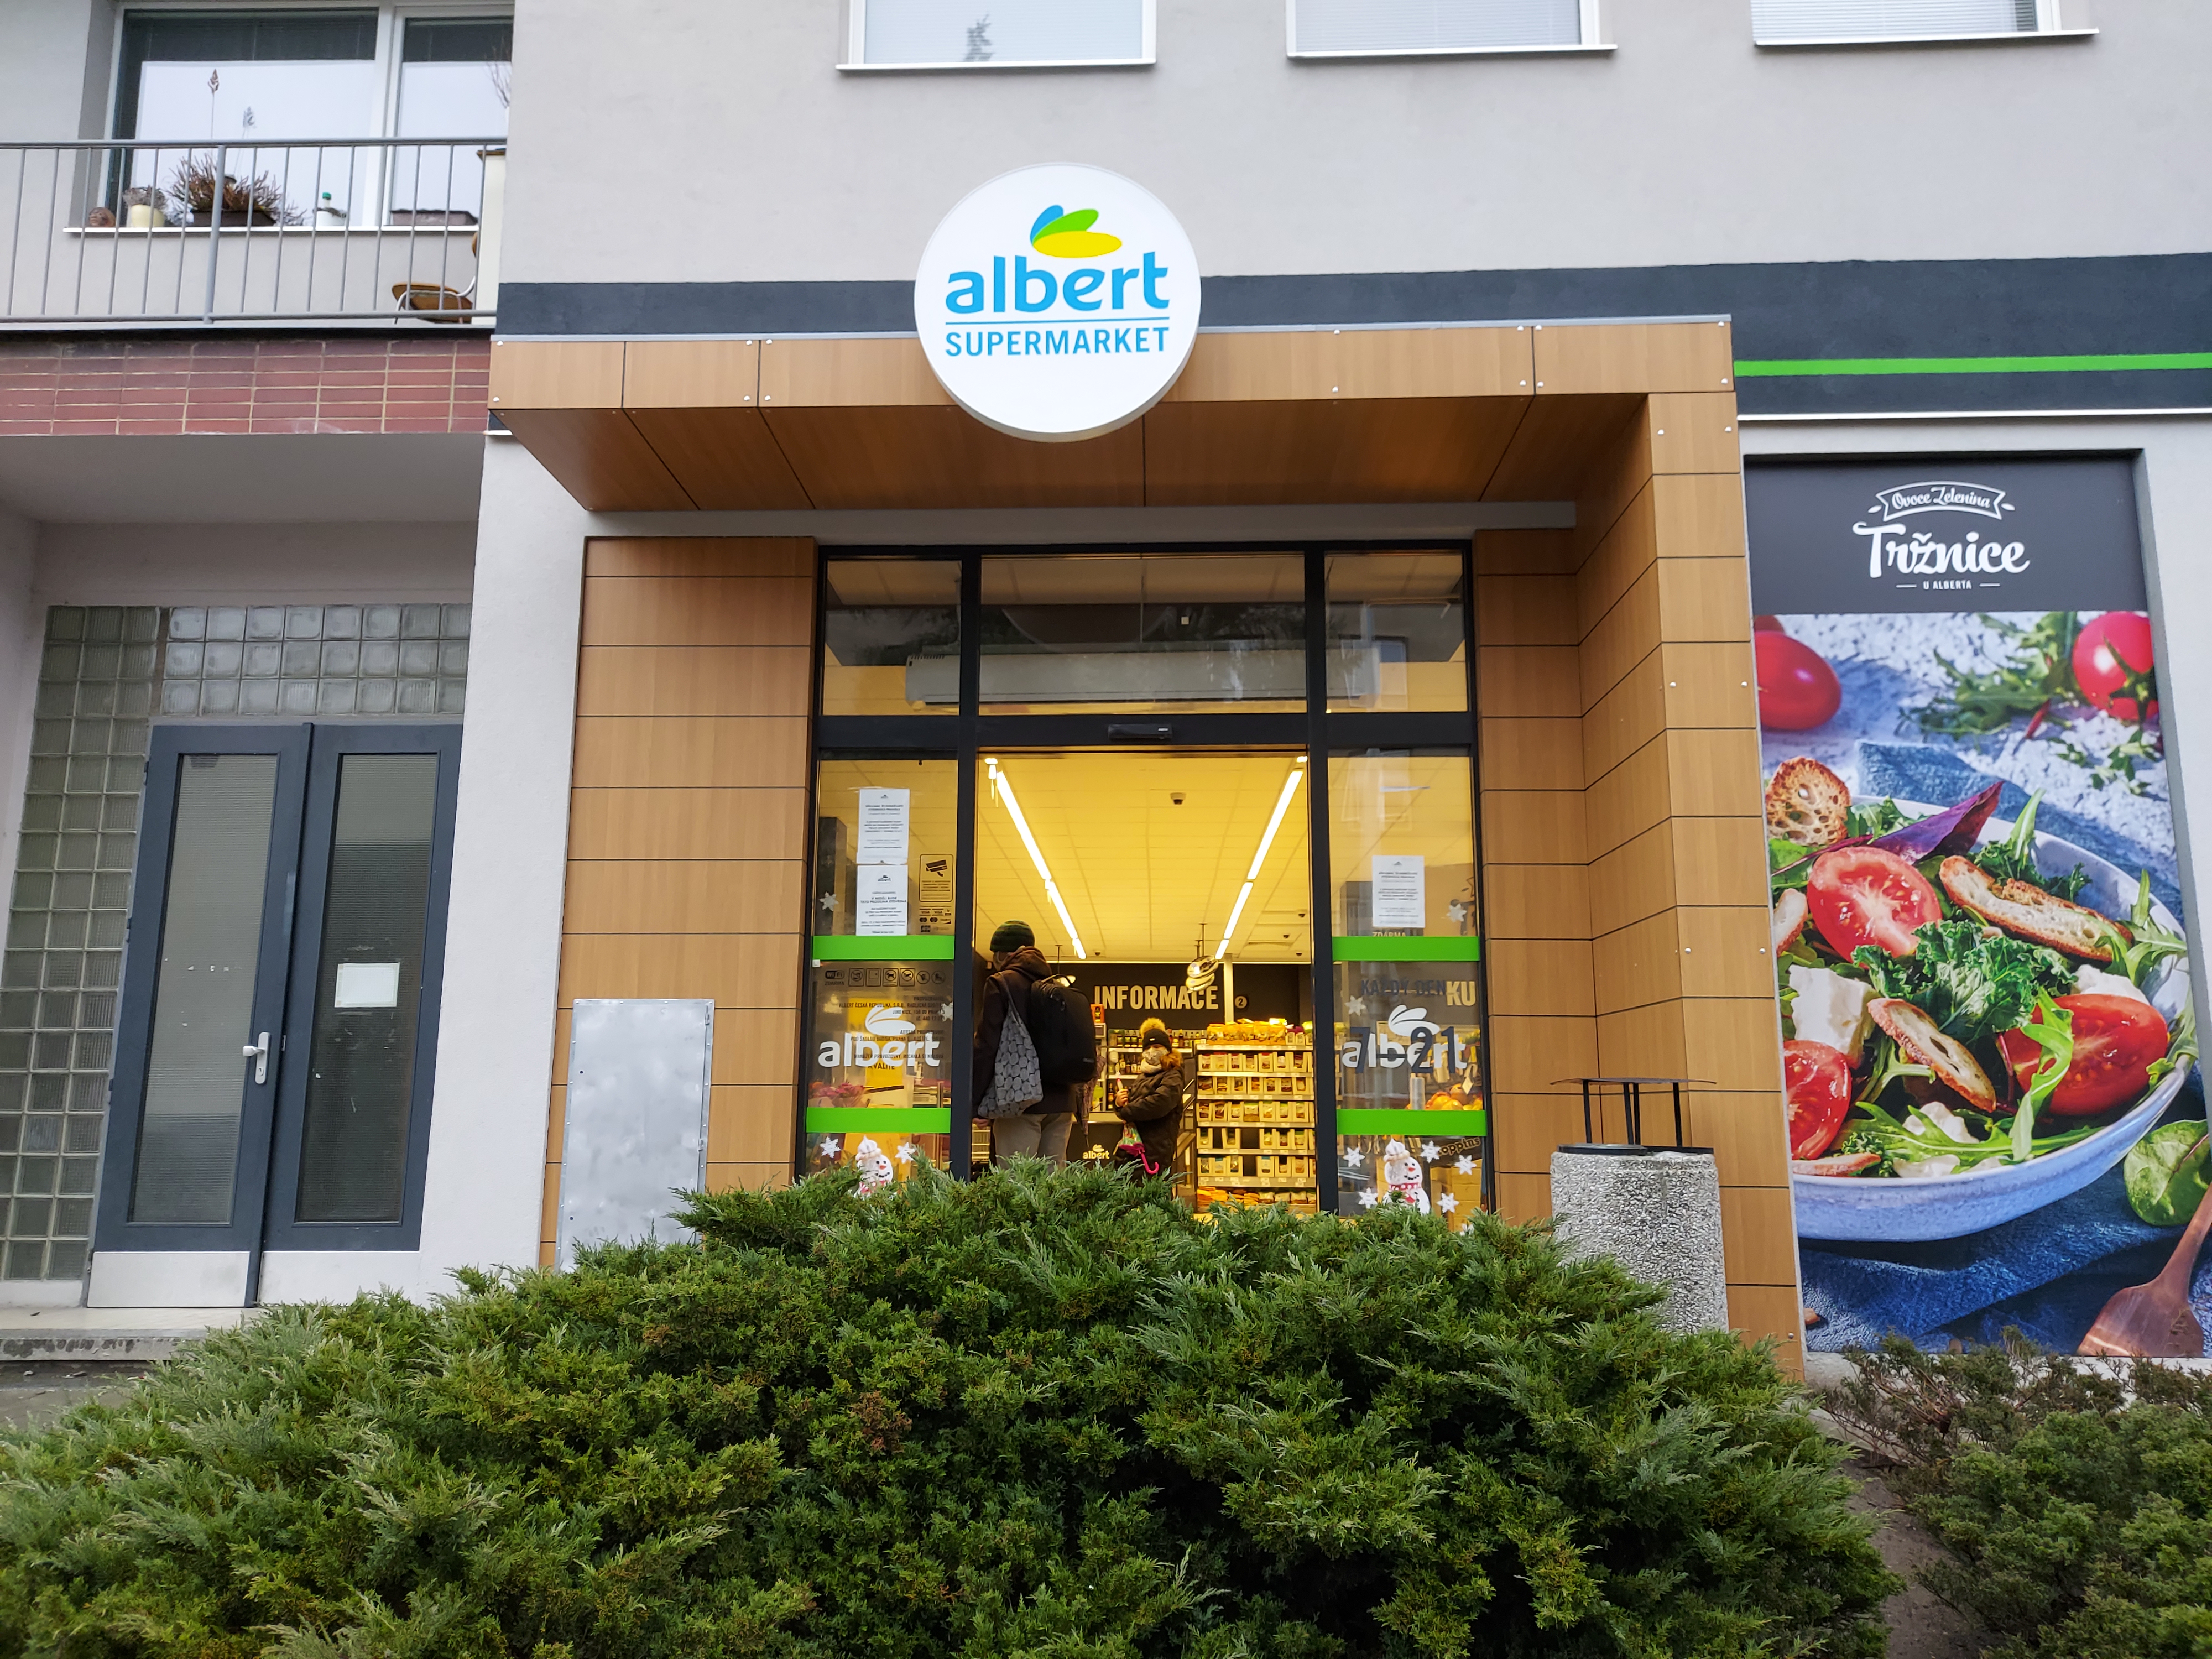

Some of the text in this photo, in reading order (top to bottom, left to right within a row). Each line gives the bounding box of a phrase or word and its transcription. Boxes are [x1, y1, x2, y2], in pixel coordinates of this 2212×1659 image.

[945, 251, 1170, 314] albert
[945, 327, 1170, 357] SUPERMARKET
[1892, 486, 1991, 509] Ovoce Zelenina
[1852, 521, 2031, 578] Tržnice
[1923, 580, 1972, 590] U ALBERTA
[1094, 985, 1219, 1009] INFORMACE
[1416, 980, 1446, 995] DEN
[1446, 980, 1476, 1006] KU
[1238, 998, 1244, 1006] 2
[818, 1032, 940, 1067] albert
[1342, 1032, 1468, 1068] albert
[1083, 1150, 1110, 1159] albert
